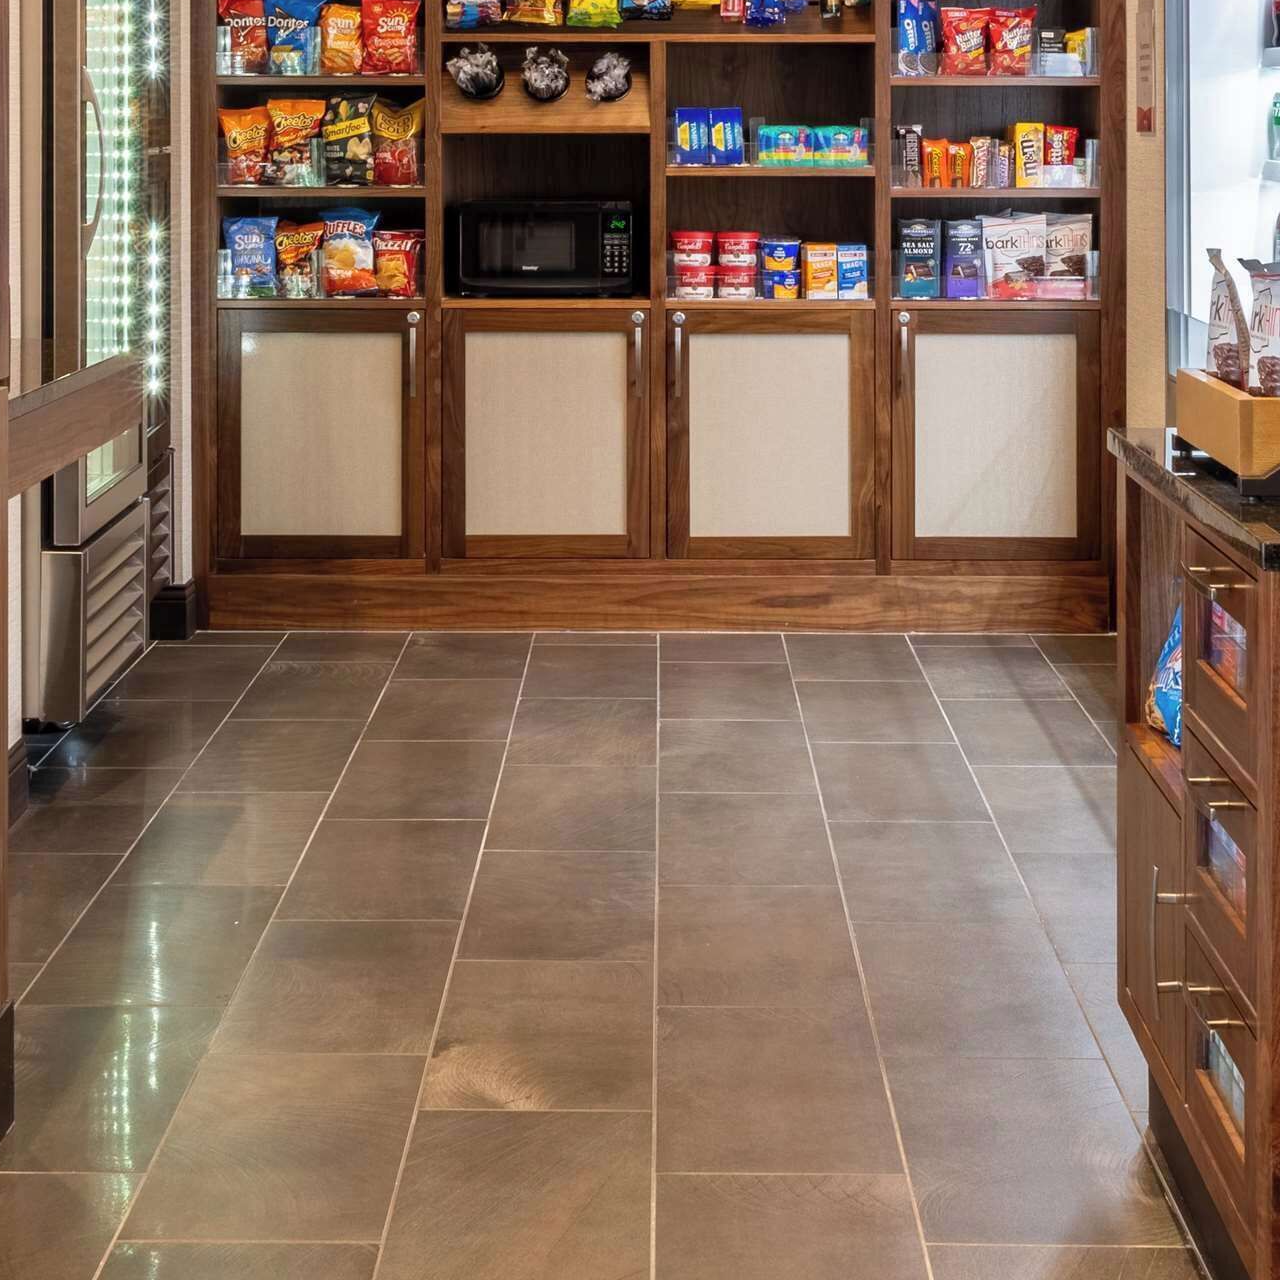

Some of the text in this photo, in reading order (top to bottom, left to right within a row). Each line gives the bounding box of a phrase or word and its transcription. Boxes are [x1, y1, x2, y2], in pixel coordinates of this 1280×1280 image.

[267, 16, 309, 29] Doritos
[377, 17, 406, 33] Sun
[904, 19, 915, 50] OREO
[922, 21, 932, 51] OREO
[956, 29, 982, 44] Nutter
[274, 115, 312, 131] Cheetos
[324, 119, 367, 139] Smartfood
[228, 125, 266, 149] Cheetos
[276, 232, 314, 249] Cheetos
